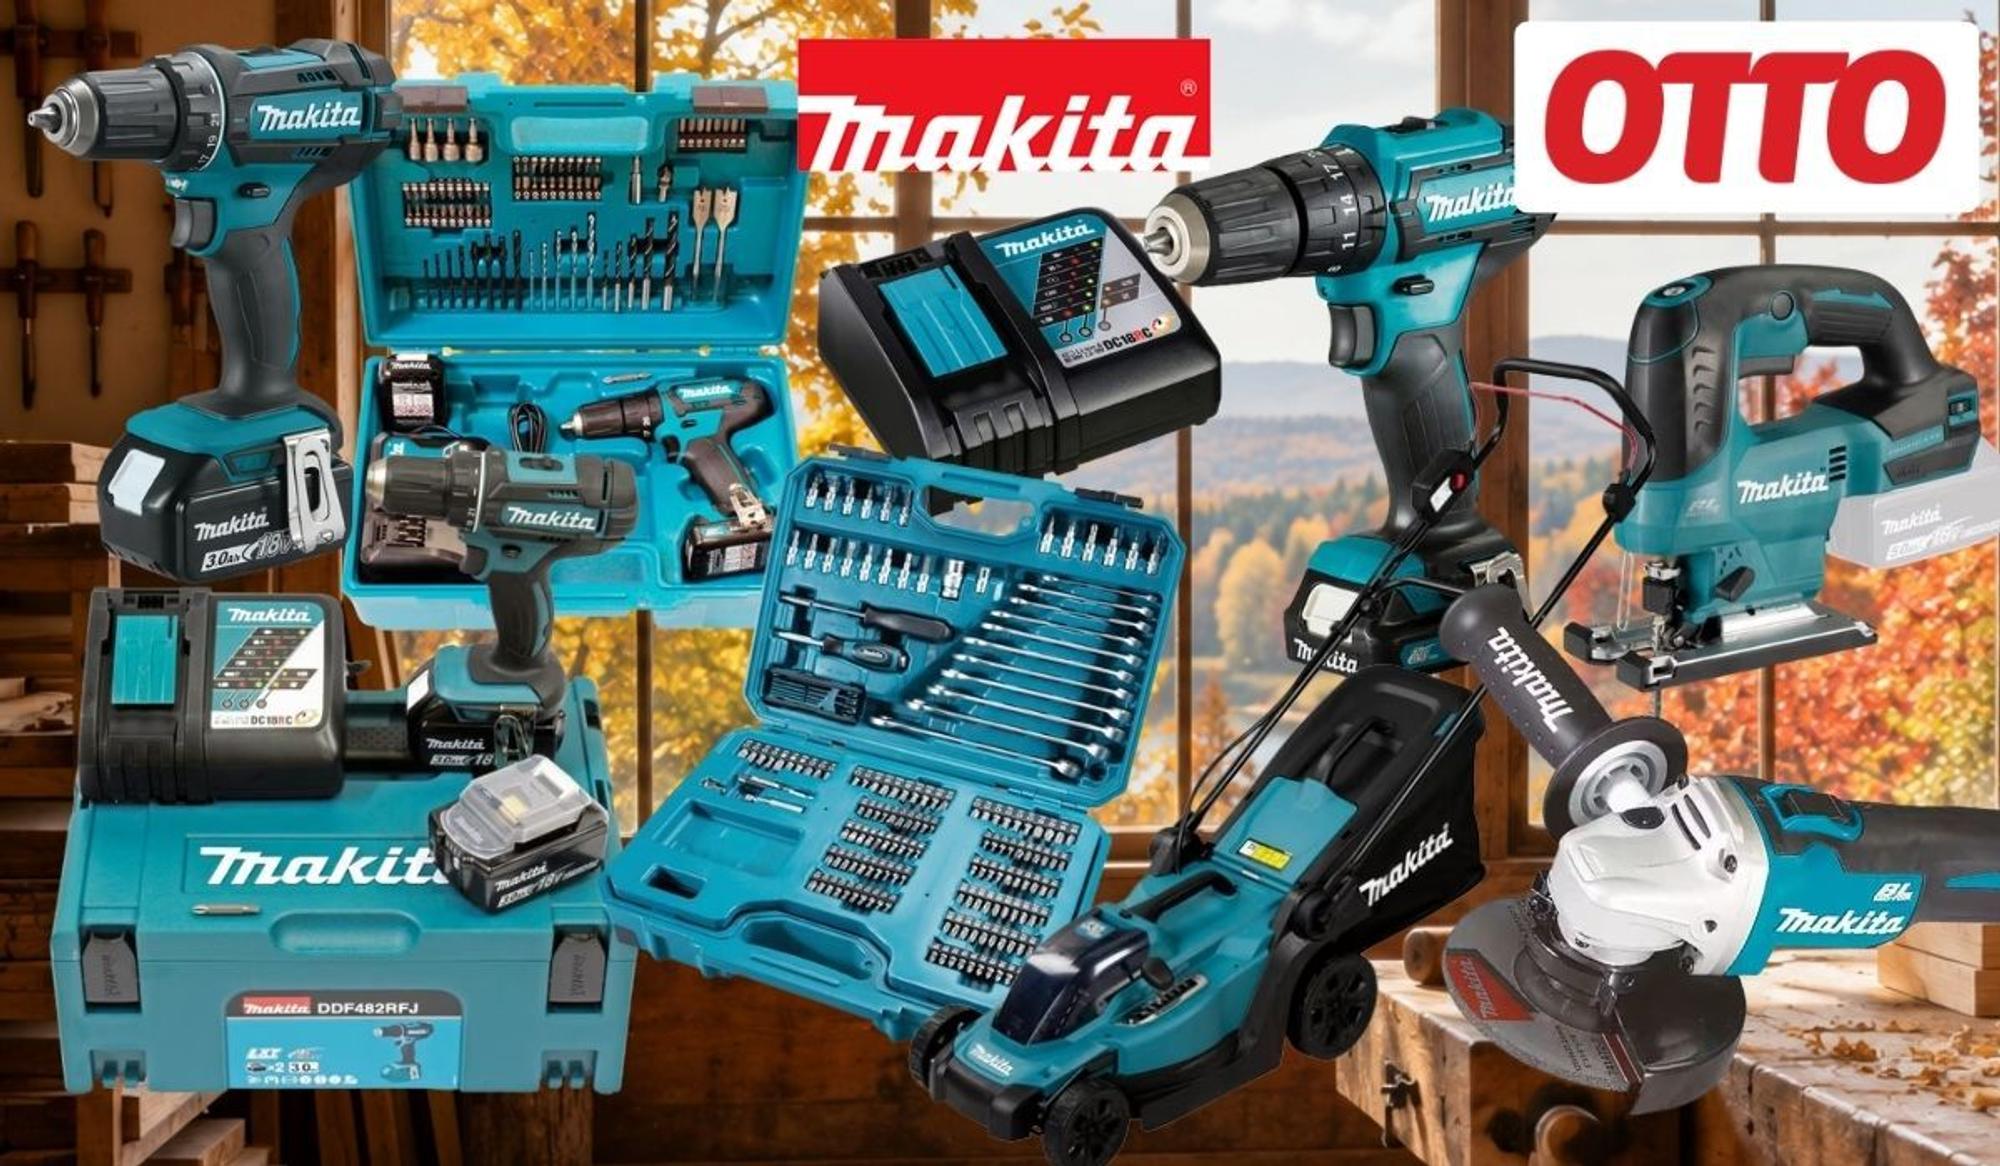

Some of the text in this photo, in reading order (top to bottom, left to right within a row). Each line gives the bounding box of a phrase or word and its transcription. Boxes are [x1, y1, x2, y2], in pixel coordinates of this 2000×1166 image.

[257, 102, 361, 131] Makita
[207, 135, 217, 147] 19
[1322, 164, 1344, 180] 17
[1340, 194, 1357, 216] 14
[994, 220, 1095, 257] Makita
[1341, 232, 1357, 250] 11
[1103, 327, 1153, 351] DC18RC
[1737, 471, 1829, 505] Makita
[194, 511, 270, 542] Makita
[507, 506, 596, 530] Makita
[227, 606, 312, 623] Makita
[1294, 637, 1359, 673] Mita
[1488, 626, 1574, 733] Makita
[426, 738, 485, 750] Makita
[1359, 823, 1454, 907] Makita
[1776, 907, 1905, 934] Makita
[243, 1003, 418, 1015] Makita DDF482RFJ
